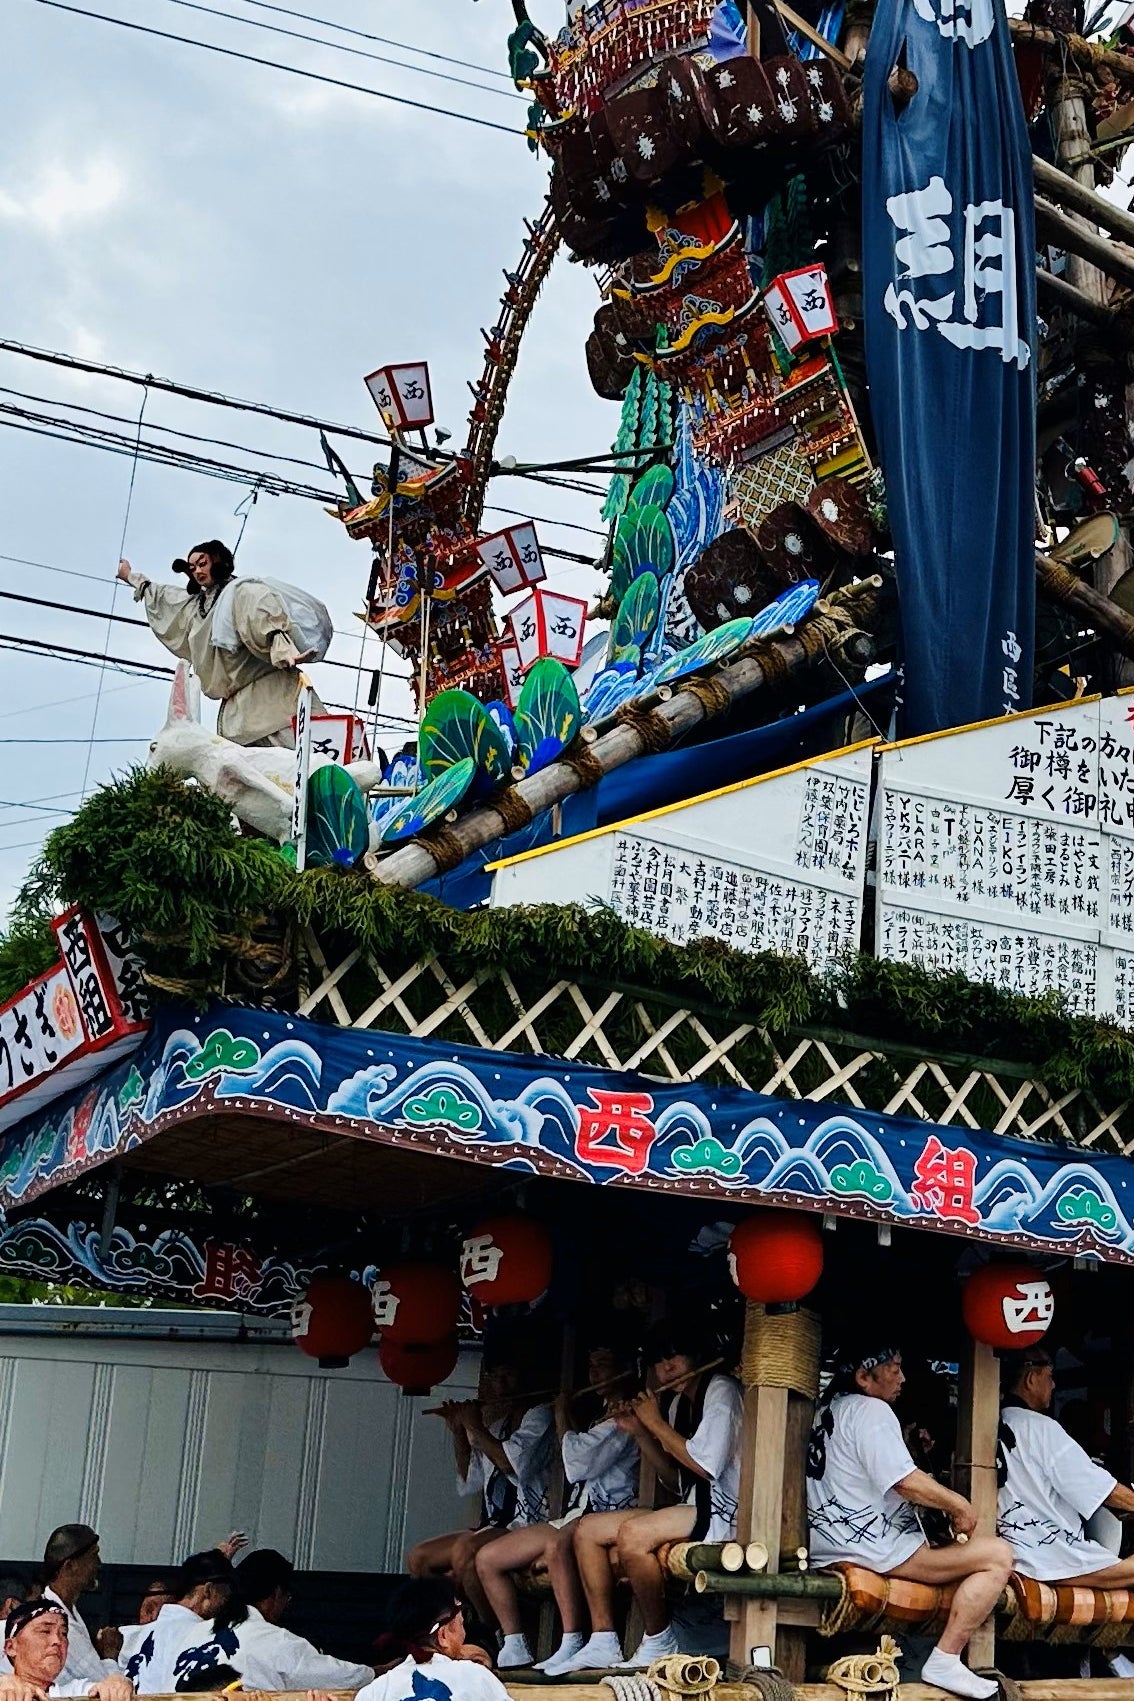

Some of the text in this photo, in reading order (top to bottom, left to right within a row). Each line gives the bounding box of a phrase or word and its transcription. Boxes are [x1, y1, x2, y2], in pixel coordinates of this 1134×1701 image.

[402, 380, 425, 401] 西
[551, 615, 577, 639] 西
[575, 1087, 656, 1174] 西
[912, 1135, 981, 1225] 組
[1002, 1281, 1055, 1334] 西
